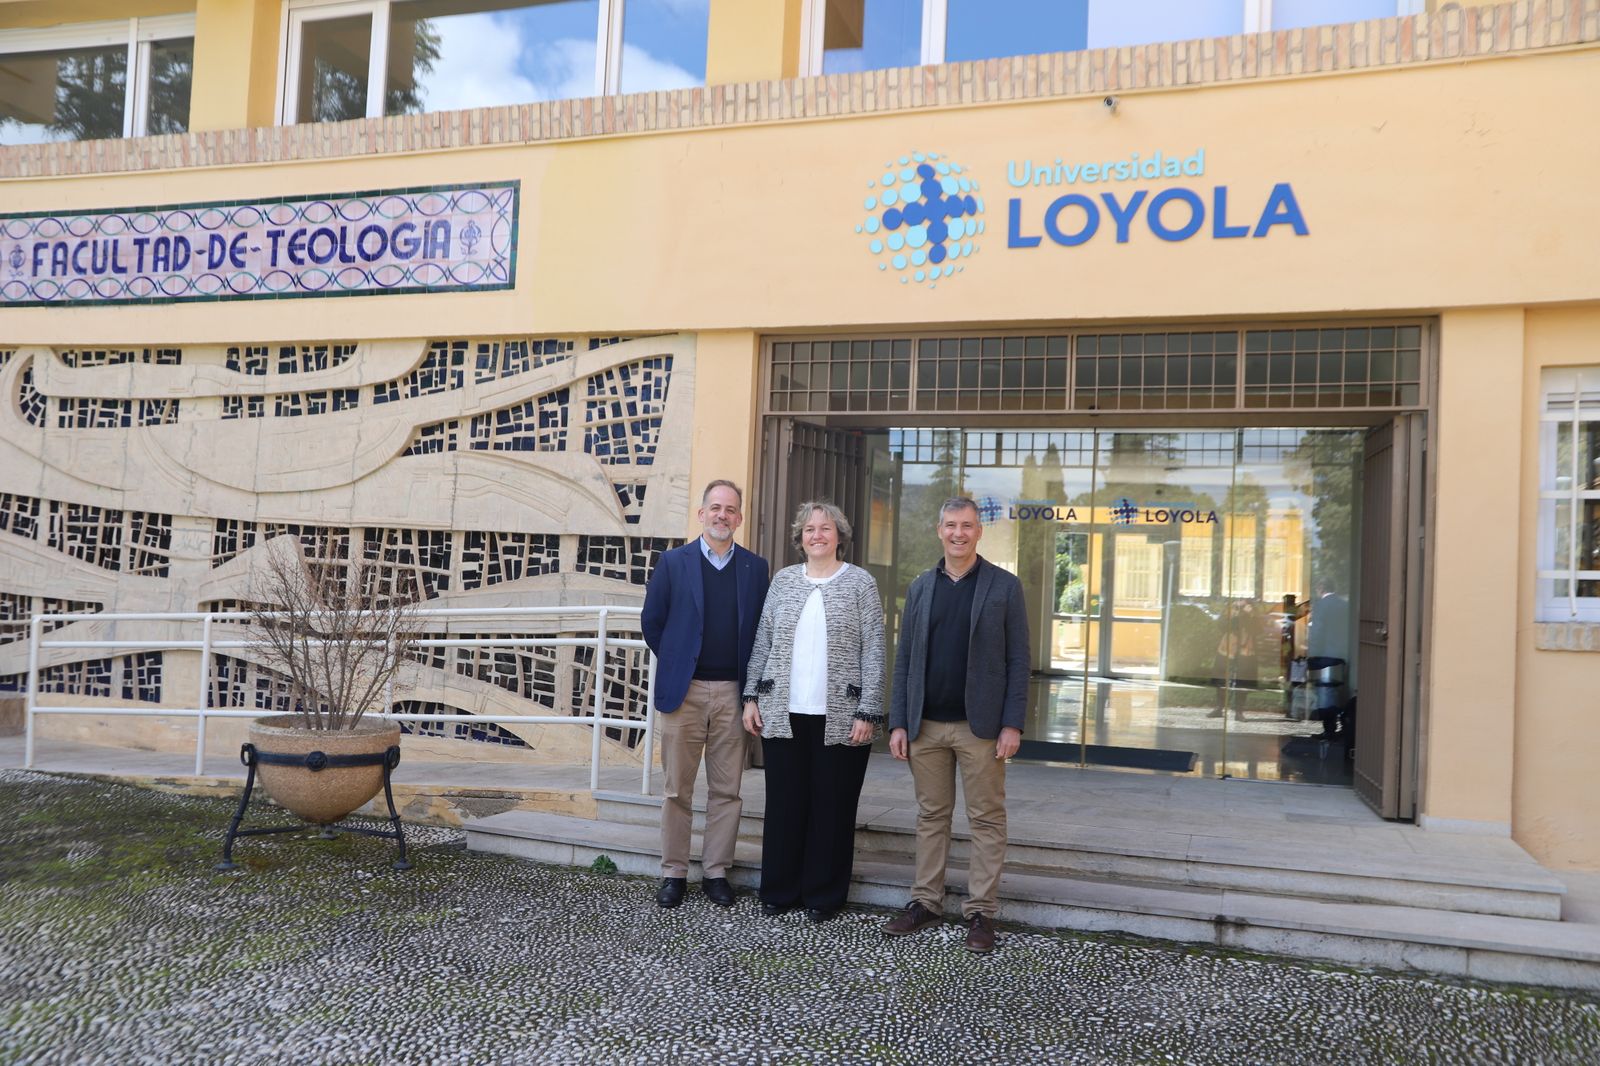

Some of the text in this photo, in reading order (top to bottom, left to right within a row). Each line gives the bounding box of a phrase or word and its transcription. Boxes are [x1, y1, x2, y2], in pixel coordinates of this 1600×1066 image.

[1007, 149, 1206, 187] Universidad
[1007, 183, 1310, 248] LOYOLA
[1008, 507, 1077, 520] LOYOLA
[1145, 509, 1218, 524] LOYOLA
